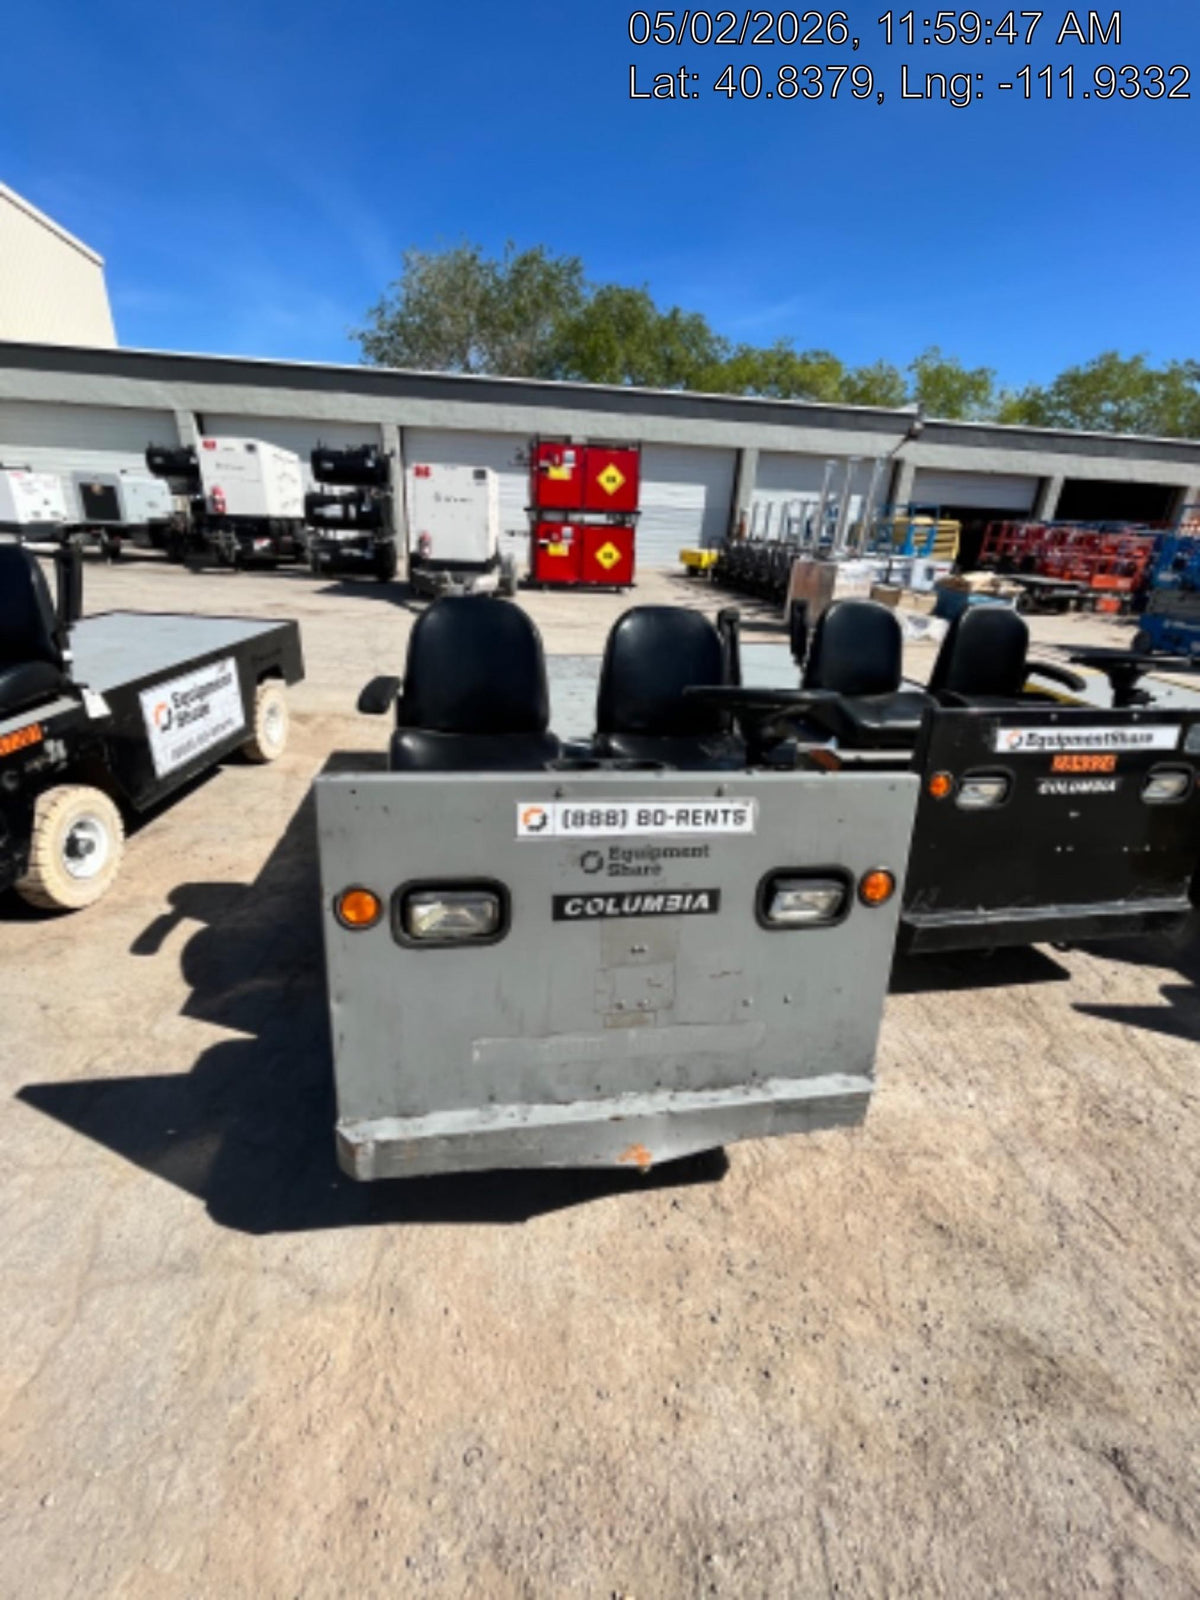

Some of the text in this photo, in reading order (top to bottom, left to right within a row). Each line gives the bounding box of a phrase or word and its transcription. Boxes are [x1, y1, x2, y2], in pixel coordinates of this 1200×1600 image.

[562, 808, 628, 828] (888)
[607, 844, 711, 863] Equipment
[607, 862, 663, 878] Share
[563, 892, 711, 917] COLUMBIA
